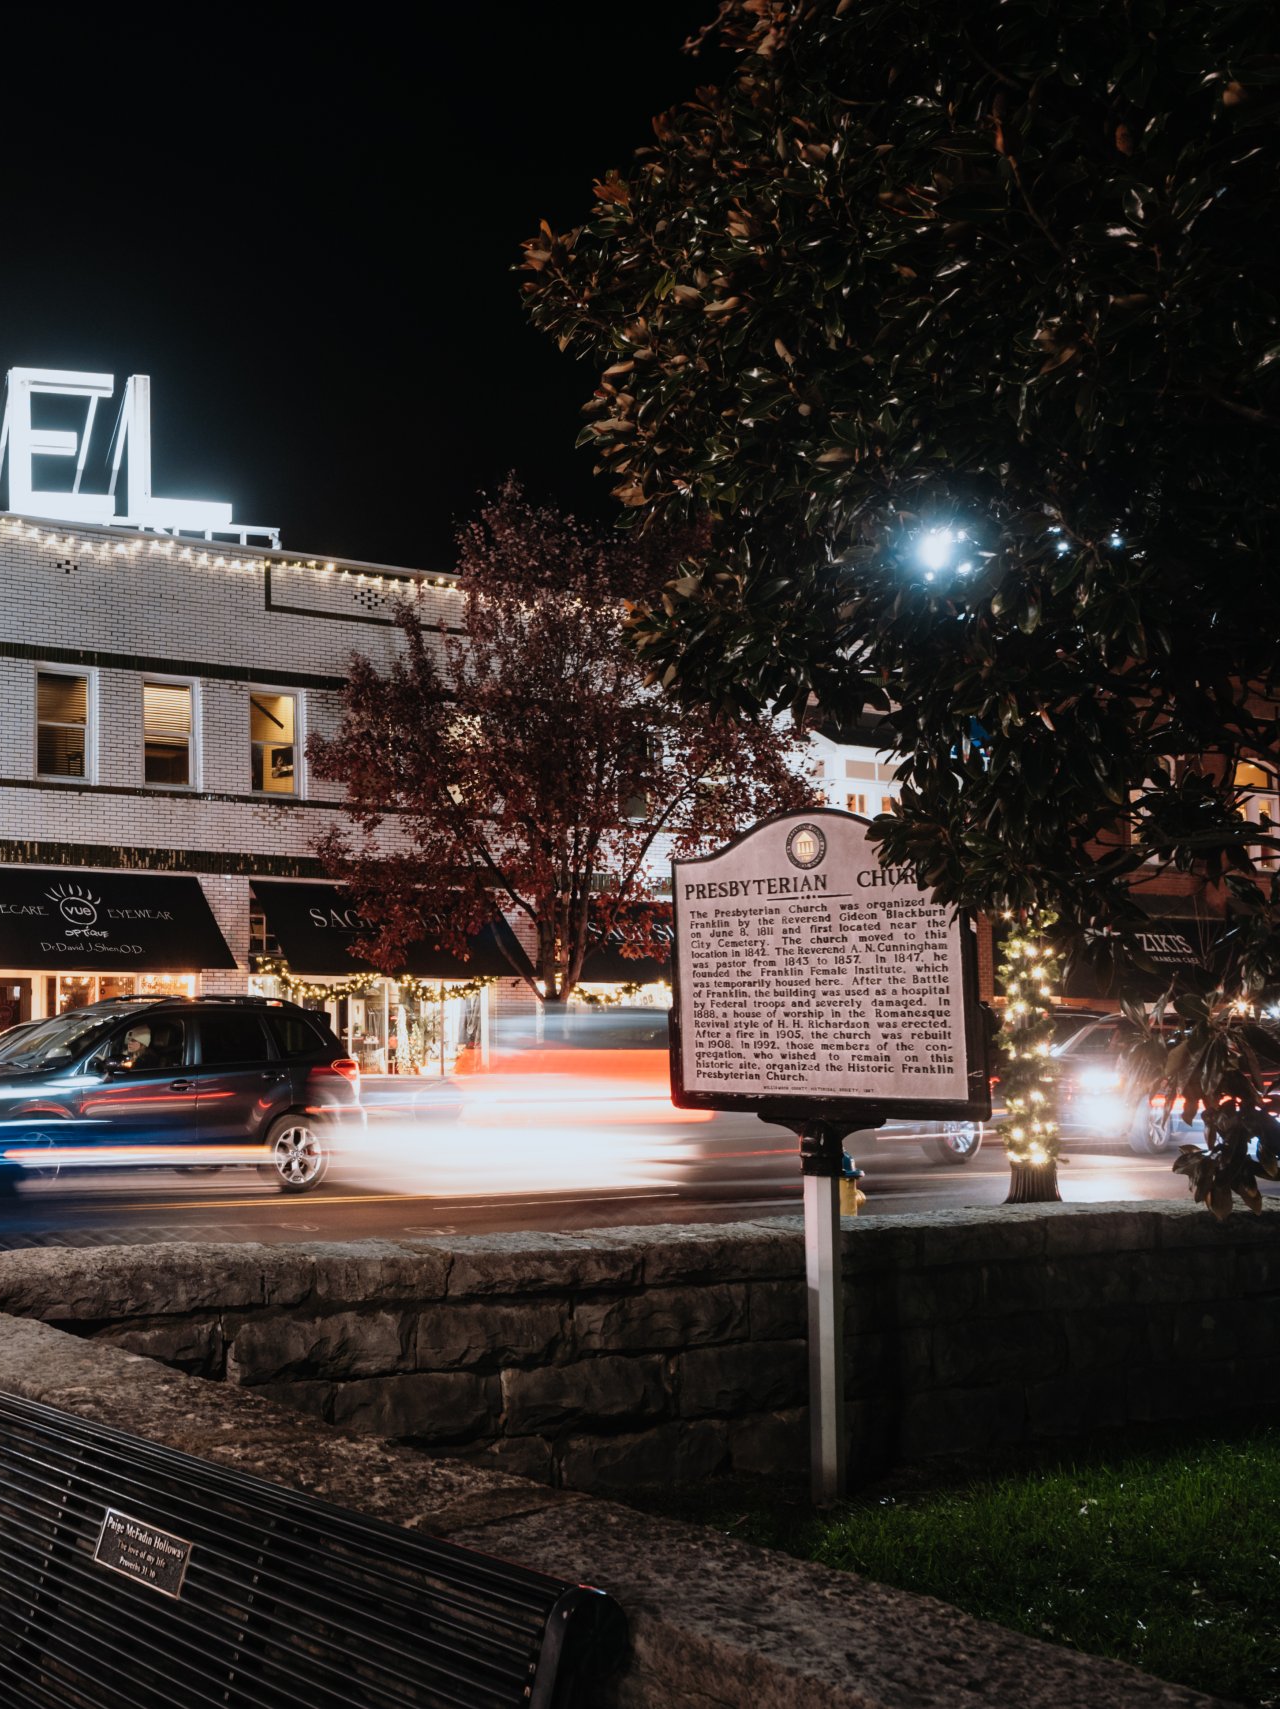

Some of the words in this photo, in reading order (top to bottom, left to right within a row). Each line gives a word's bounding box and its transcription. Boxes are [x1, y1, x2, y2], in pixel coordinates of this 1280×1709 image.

[685, 874, 828, 900] PRESBYTERIAN
[107, 909, 173, 920] EYEWEAR
[689, 909, 707, 919] The
[714, 905, 780, 920] Presbyterian
[788, 903, 827, 914] Church
[839, 903, 859, 911] was
[866, 897, 924, 911] organized
[690, 918, 729, 928] Franklin
[738, 917, 750, 928] by
[757, 916, 774, 925] the
[781, 913, 831, 924] Reverend
[839, 911, 877, 922] Gideon
[886, 908, 945, 920] Blackburn
[709, 927, 733, 937] June
[757, 926, 773, 935] 1811
[781, 924, 801, 934] and
[809, 923, 832, 933] first
[839, 921, 881, 932] located
[926, 918, 946, 928] the
[691, 939, 711, 950] City
[717, 936, 769, 949] Cemetery.
[781, 935, 802, 945] The
[810, 933, 848, 944] church
[858, 932, 893, 942] moved
[903, 931, 915, 940] to
[924, 930, 947, 939] this
[691, 948, 728, 958] location
[731, 948, 740, 957] in
[744, 947, 769, 957] 1842.
[774, 946, 795, 956] The
[797, 945, 845, 955] Reverend
[850, 944, 862, 953] A.
[864, 944, 875, 953] N.
[878, 941, 948, 954] Cunningham
[716, 958, 746, 969] pastor
[753, 957, 776, 966] from
[785, 956, 811, 965] 1843
[817, 955, 828, 965] to
[834, 955, 861, 964] 1857.
[876, 954, 886, 963] In
[933, 952, 948, 961] he
[692, 968, 730, 977] founded
[736, 967, 752, 976] the
[760, 966, 803, 976] Franklin
[810, 965, 847, 975] Female
[915, 963, 948, 972] which
[713, 977, 771, 989] temporarily
[775, 977, 810, 986] housed
[815, 976, 843, 985] here.
[851, 975, 882, 985] After
[887, 975, 906, 984] the
[912, 974, 949, 984] Battle
[692, 989, 702, 998] of
[754, 988, 770, 997] the
[773, 987, 816, 999] building
[844, 987, 869, 996] used
[901, 986, 949, 997] hospital
[693, 999, 705, 1010] by
[710, 999, 746, 1008] Federal
[753, 999, 785, 1010] troops
[790, 998, 810, 1007] and
[815, 998, 862, 1009] severely
[870, 998, 926, 1009] damaged.
[938, 998, 950, 1007] In
[733, 1009, 761, 1017] house
[766, 1009, 776, 1017] of
[782, 1009, 824, 1019] worship
[831, 1009, 840, 1017] in
[848, 1009, 865, 1017] the
[875, 1009, 950, 1019] Romanesque
[694, 1019, 729, 1028] Revival
[733, 1019, 759, 1030] style
[762, 1019, 773, 1028] of
[777, 1019, 788, 1028] H.
[792, 1019, 803, 1028] H.
[808, 1019, 869, 1028] Richardson
[901, 1019, 951, 1028] erected.
[695, 1029, 721, 1038] After
[736, 1029, 754, 1038] fire
[759, 1030, 769, 1038] in
[810, 1030, 828, 1039] the
[832, 1030, 871, 1039] church
[910, 1030, 951, 1039] rebuilt
[695, 1039, 704, 1048] in
[708, 1039, 734, 1048] 1908.
[741, 1040, 749, 1049] In
[785, 1040, 814, 1049] those
[820, 1040, 869, 1050] members
[876, 1041, 888, 1050] of
[895, 1041, 914, 1050] the
[753, 1050, 773, 1060] who
[780, 1051, 816, 1060] wished
[828, 1051, 840, 1060] to
[851, 1052, 891, 1061] remain
[930, 1053, 953, 1062] this
[696, 1059, 733, 1069] historic
[765, 1060, 820, 1072] organized
[825, 1062, 843, 1071] the
[847, 1062, 894, 1072] Historic
[901, 1063, 954, 1073] Franklin
[696, 1070, 760, 1082] Presbyterian
[766, 1071, 807, 1081] Church.
[107, 1516, 125, 1535] Paige
[153, 1535, 186, 1563] Holloway
[119, 1555, 141, 1572] Proverbs
[127, 1545, 139, 1557] love
[139, 1550, 146, 1559] of
[147, 1554, 155, 1564] my
[156, 1556, 166, 1568] life
